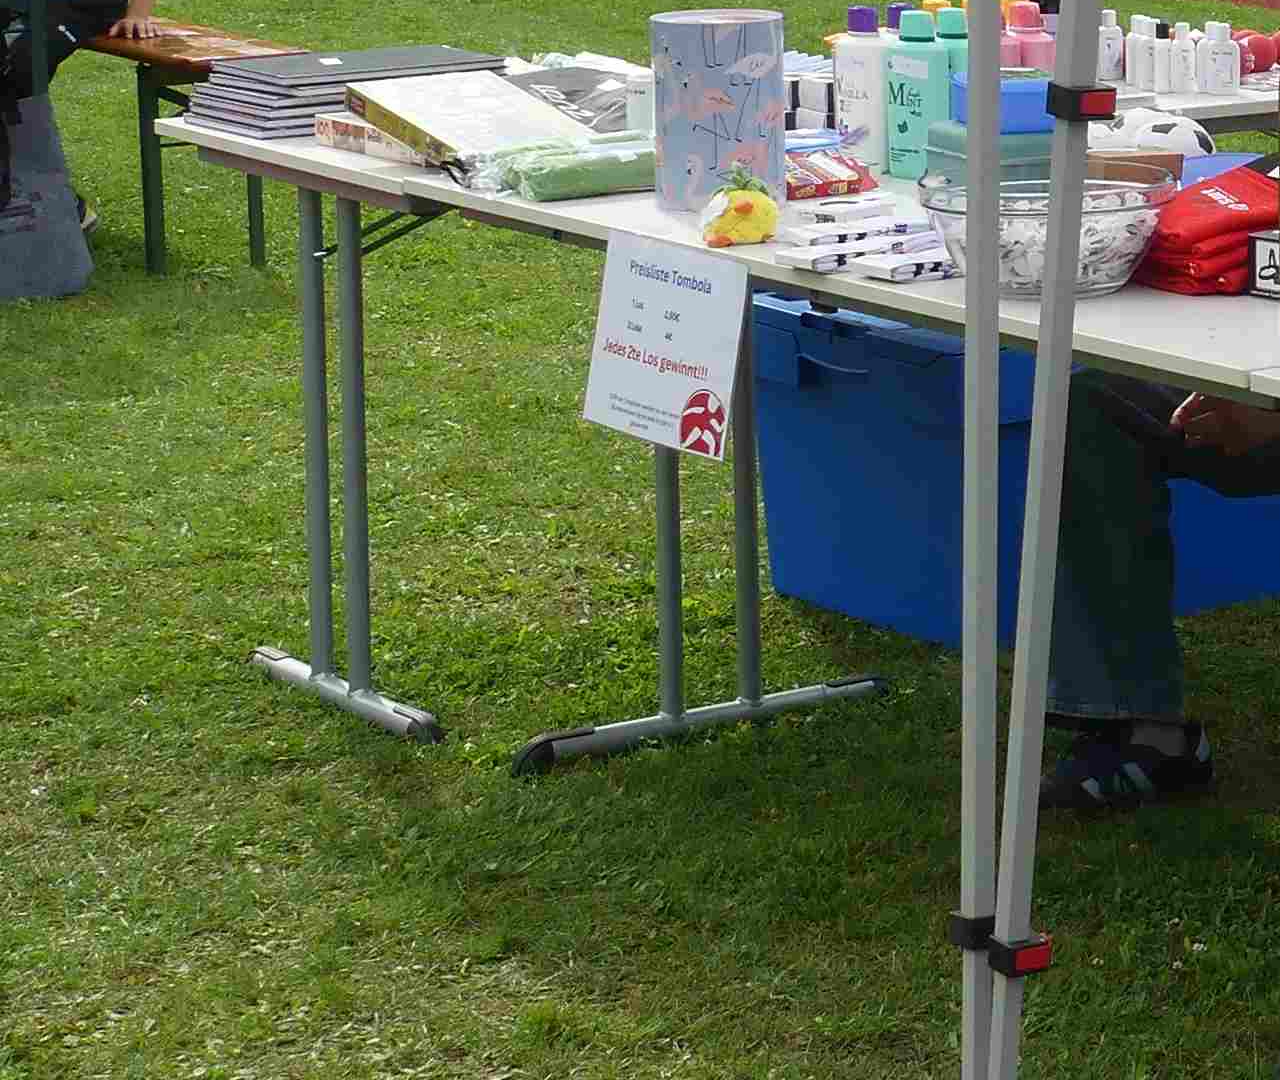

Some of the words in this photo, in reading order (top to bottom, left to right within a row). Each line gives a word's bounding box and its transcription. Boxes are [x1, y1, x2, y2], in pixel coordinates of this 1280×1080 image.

[629, 259, 670, 283] Preisliste
[671, 269, 712, 295] Tombola
[603, 337, 627, 356] Jedes
[627, 344, 641, 361] 2te
[642, 348, 658, 367] Los
[658, 357, 710, 381] gewinnt!!!
